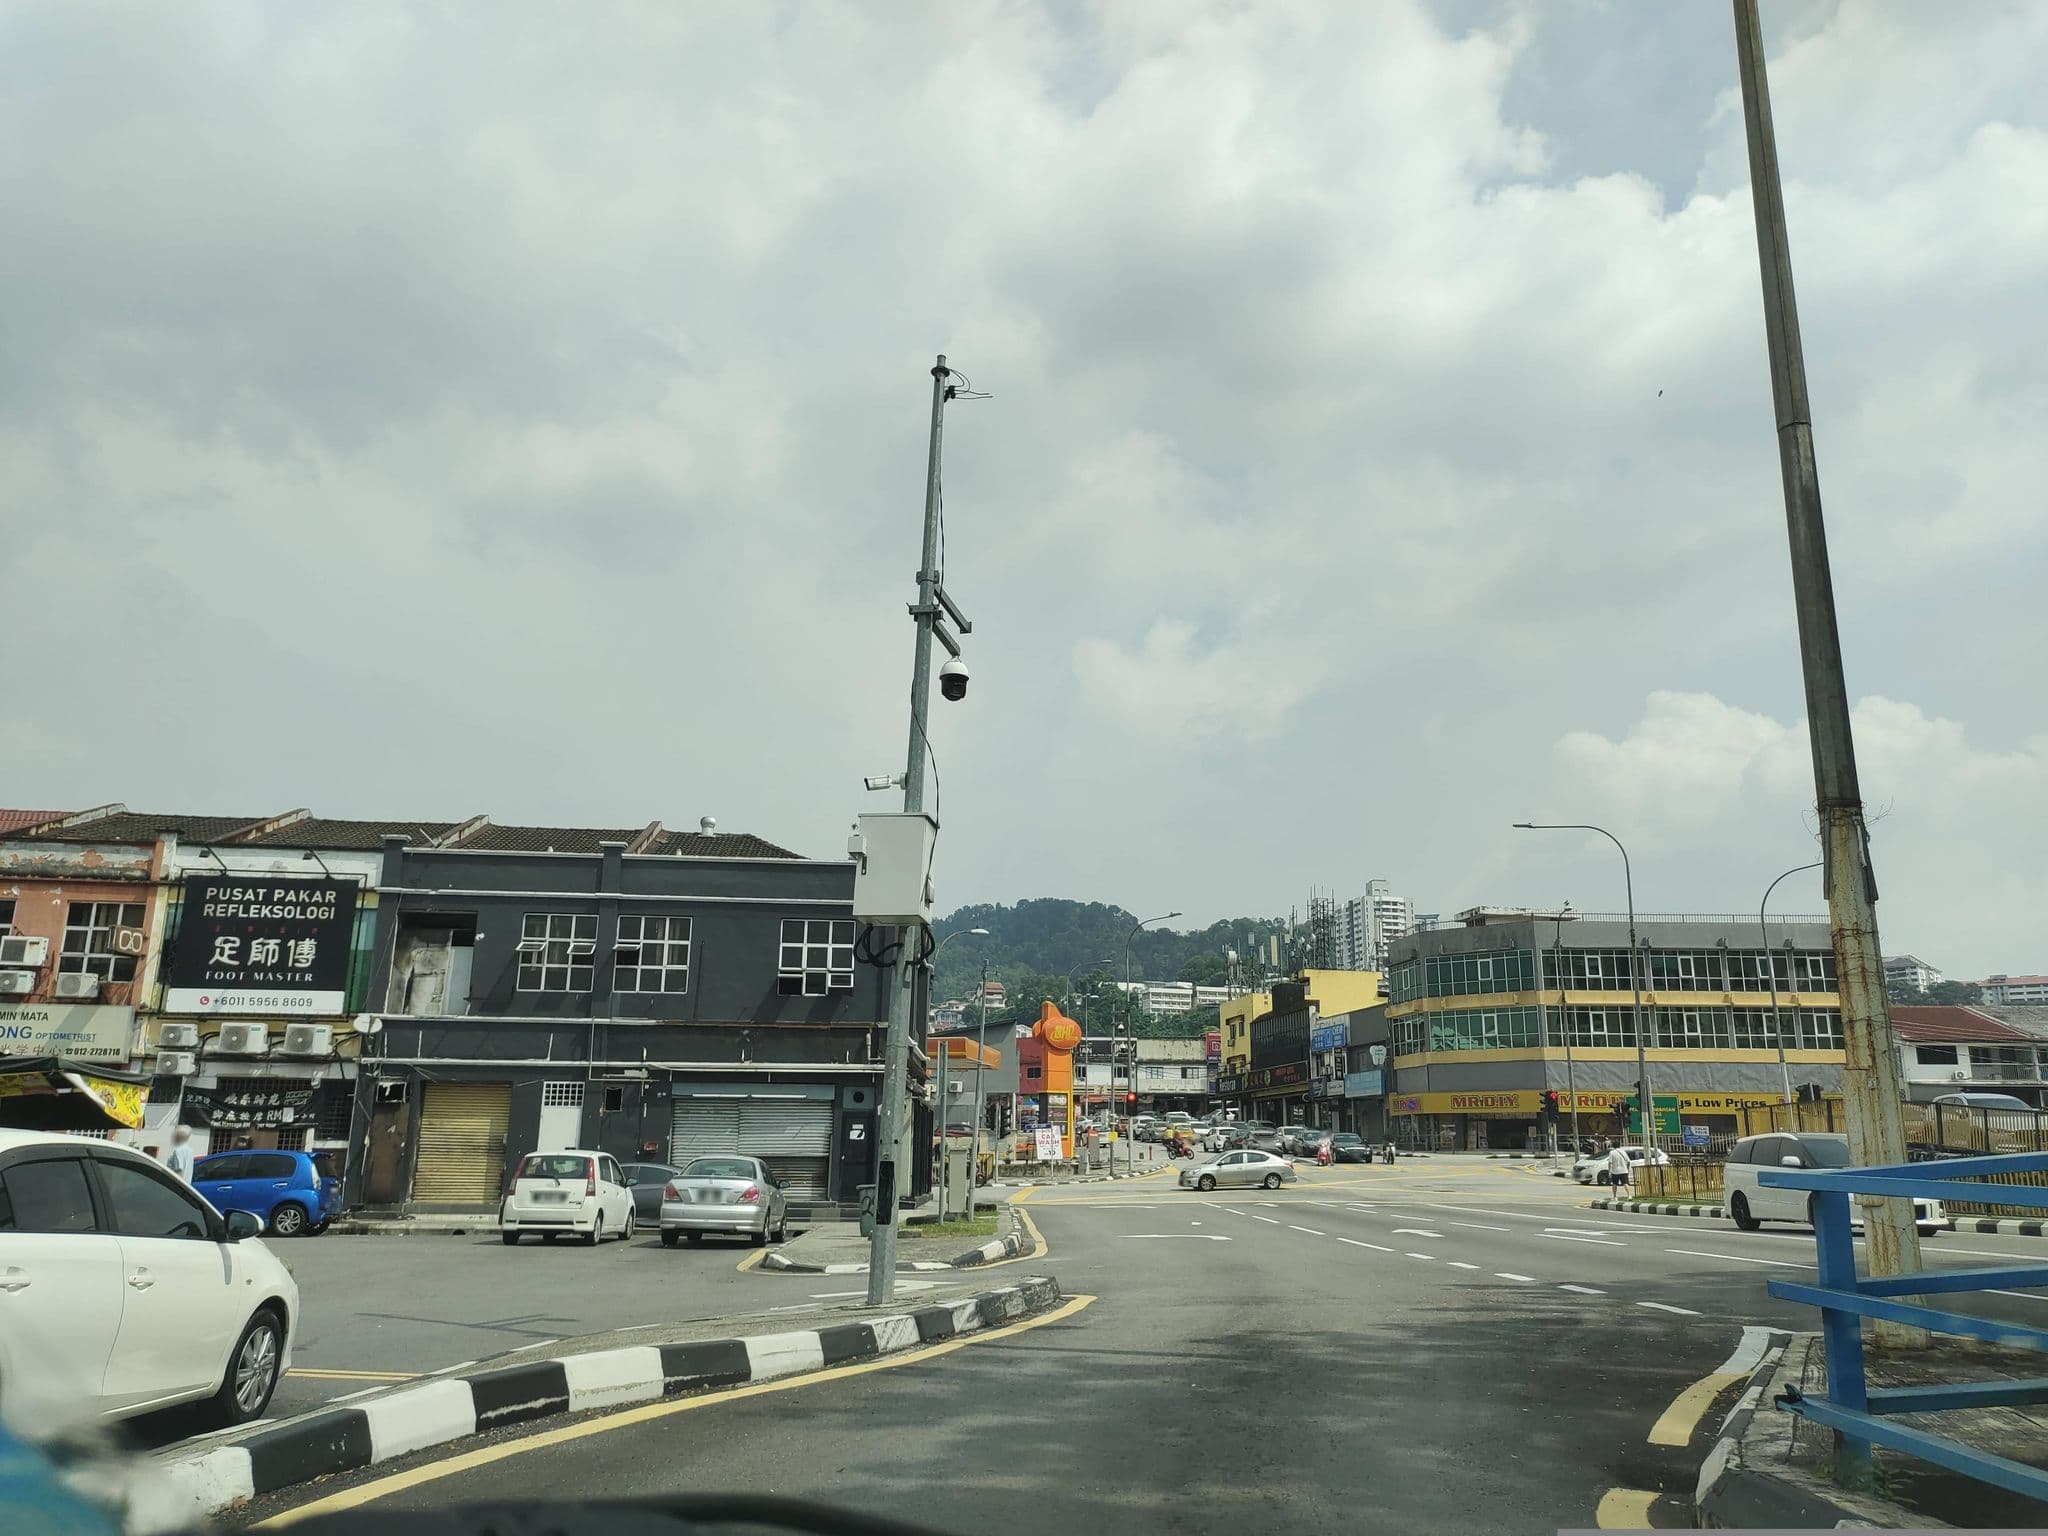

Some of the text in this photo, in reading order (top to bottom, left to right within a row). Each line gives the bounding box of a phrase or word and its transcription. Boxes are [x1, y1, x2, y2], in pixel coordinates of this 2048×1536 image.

[205, 887, 337, 903] PUSAT PAKAR
[203, 904, 335, 920] REFLEKSOLOGI
[205, 971, 314, 982] FOOT MASTER
[213, 996, 313, 1007] +6011 5956 8609
[20, 1011, 49, 1022] MATA
[35, 1032, 96, 1041] OPTOMETRIST
[1695, 1098, 1722, 1108] Low
[1725, 1098, 1767, 1109] Prices
